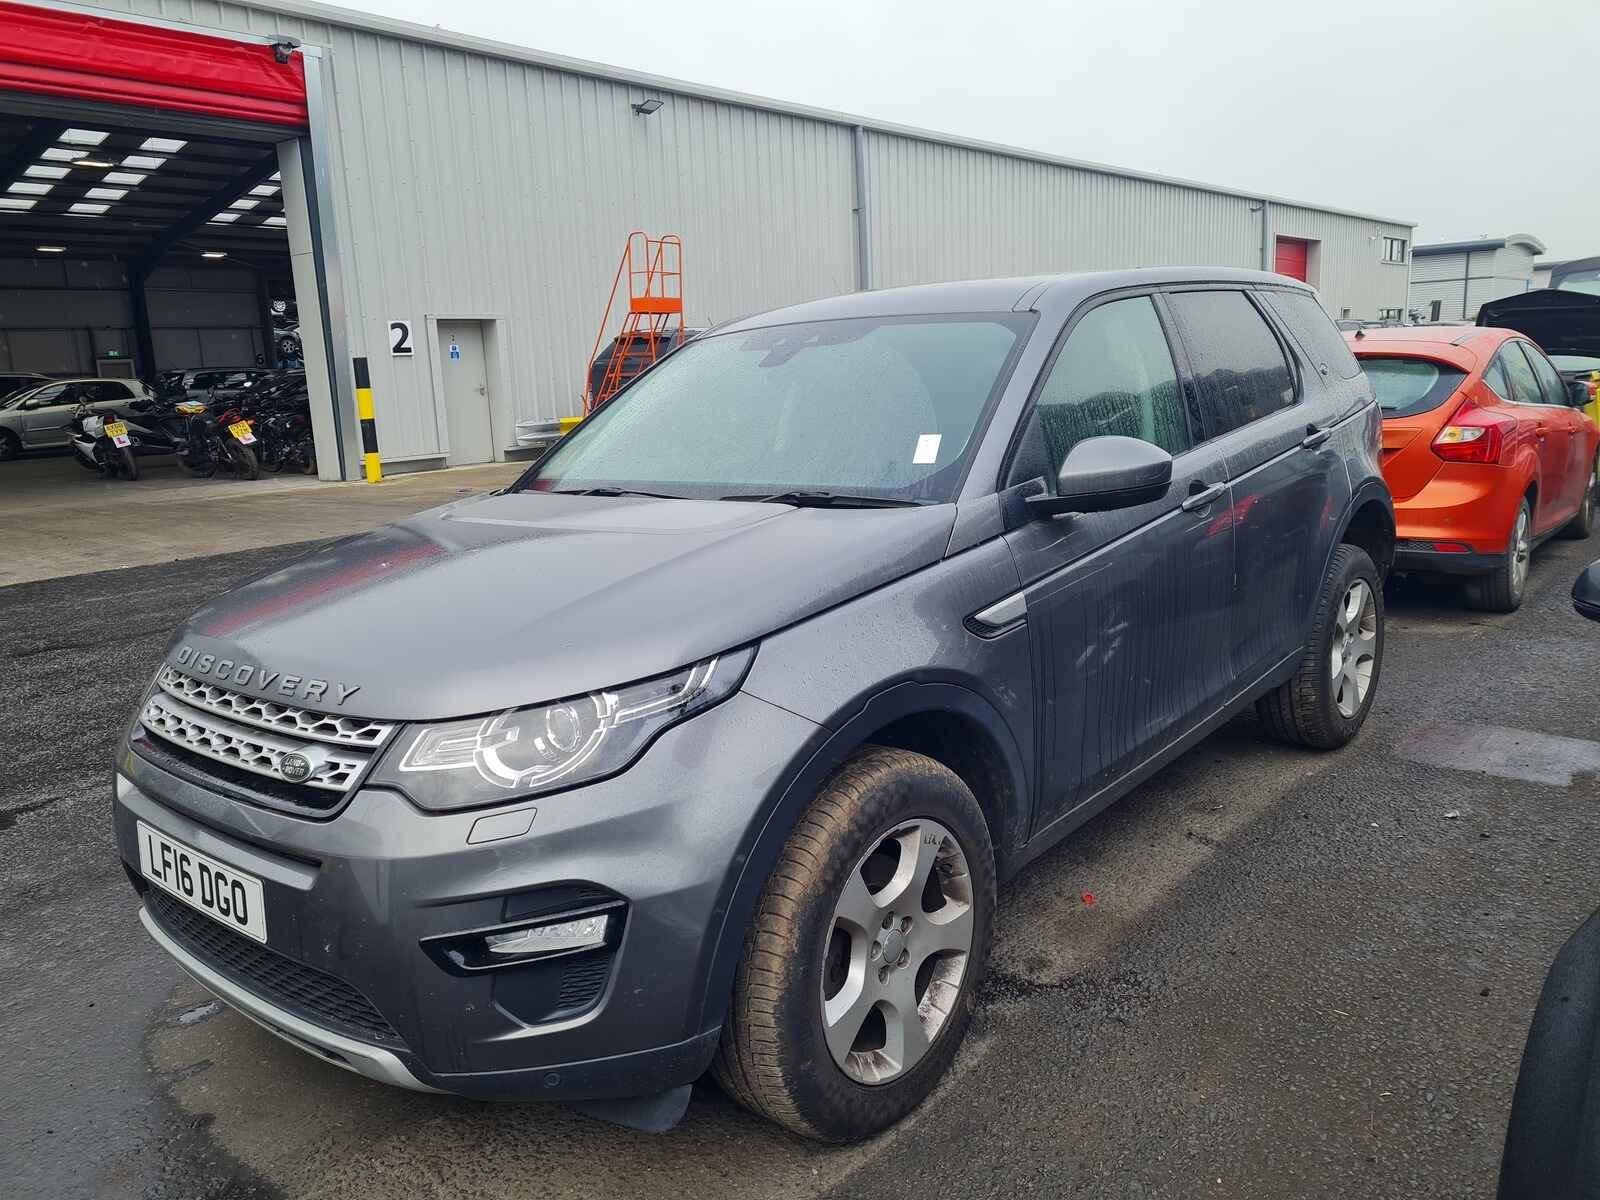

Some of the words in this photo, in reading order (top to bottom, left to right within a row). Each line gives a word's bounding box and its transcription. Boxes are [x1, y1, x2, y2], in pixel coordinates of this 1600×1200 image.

[390, 322, 412, 353] 2
[176, 646, 360, 706] DISCOVERY
[149, 835, 194, 897] LF16
[199, 862, 248, 925] DGO
